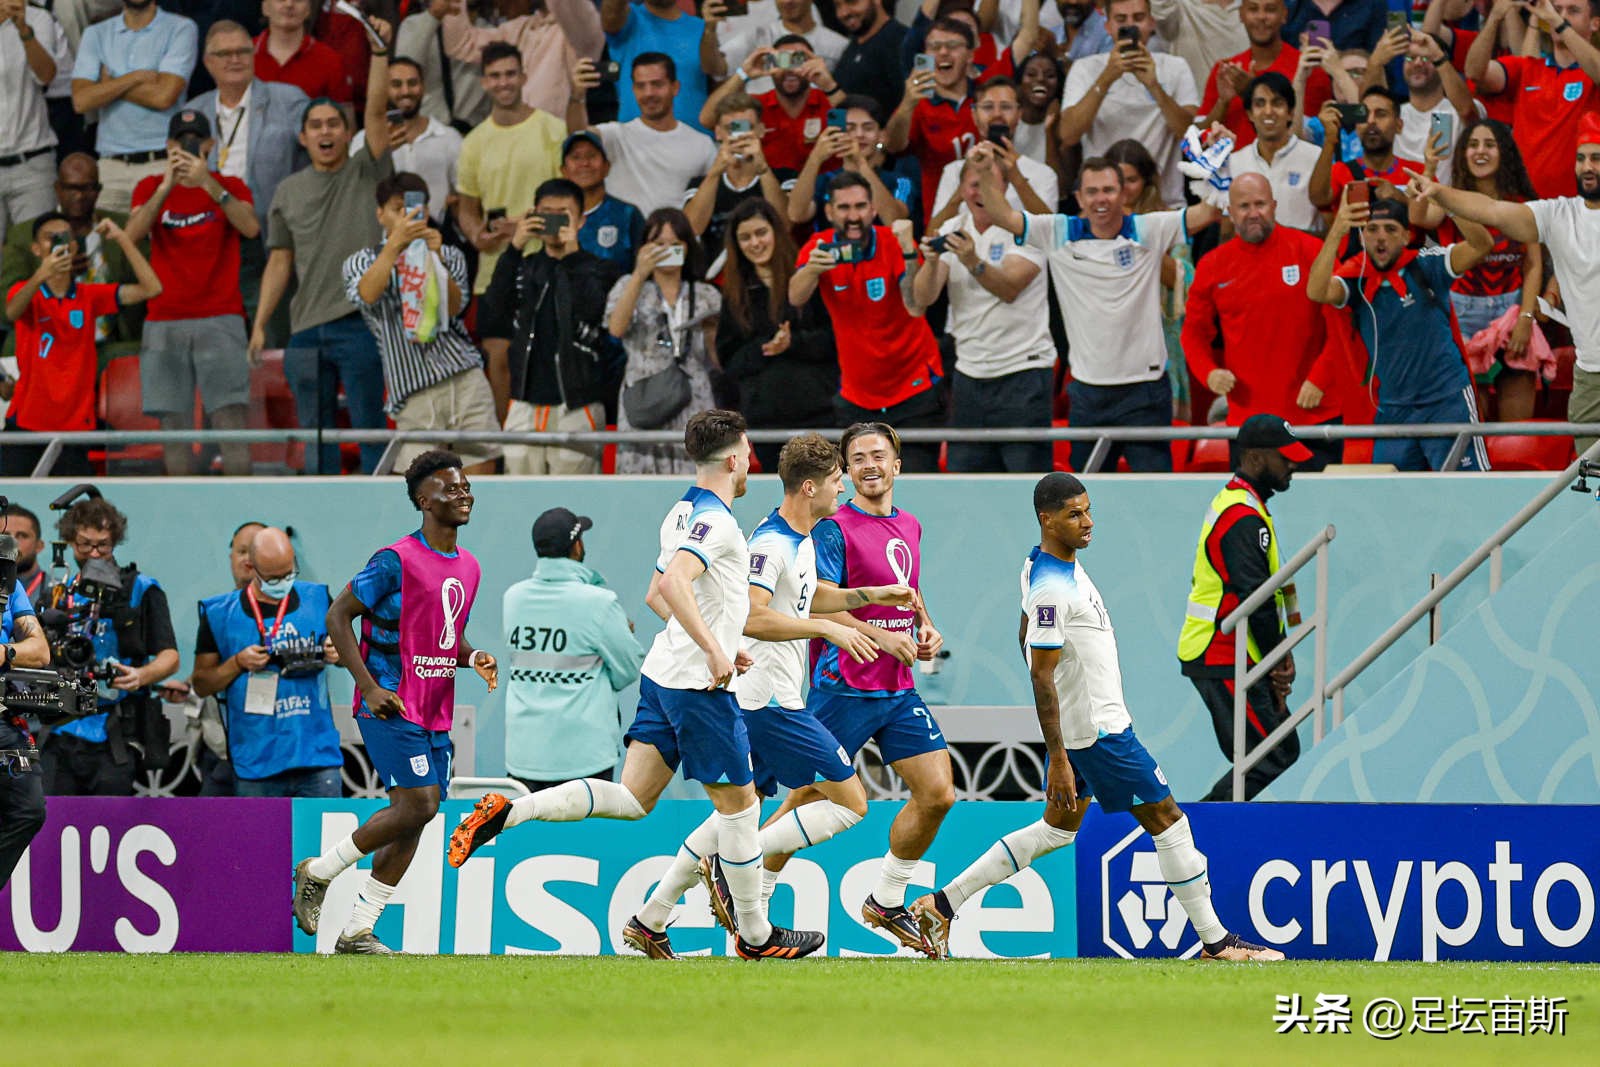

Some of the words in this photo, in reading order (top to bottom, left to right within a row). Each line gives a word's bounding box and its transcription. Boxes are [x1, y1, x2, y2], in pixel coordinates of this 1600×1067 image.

[797, 583, 808, 611] 5
[510, 625, 568, 653] 4370
[412, 655, 433, 666] FIFA
[913, 707, 932, 728] 7
[316, 812, 1055, 958] Hisense
[1249, 841, 1595, 962] crypto
